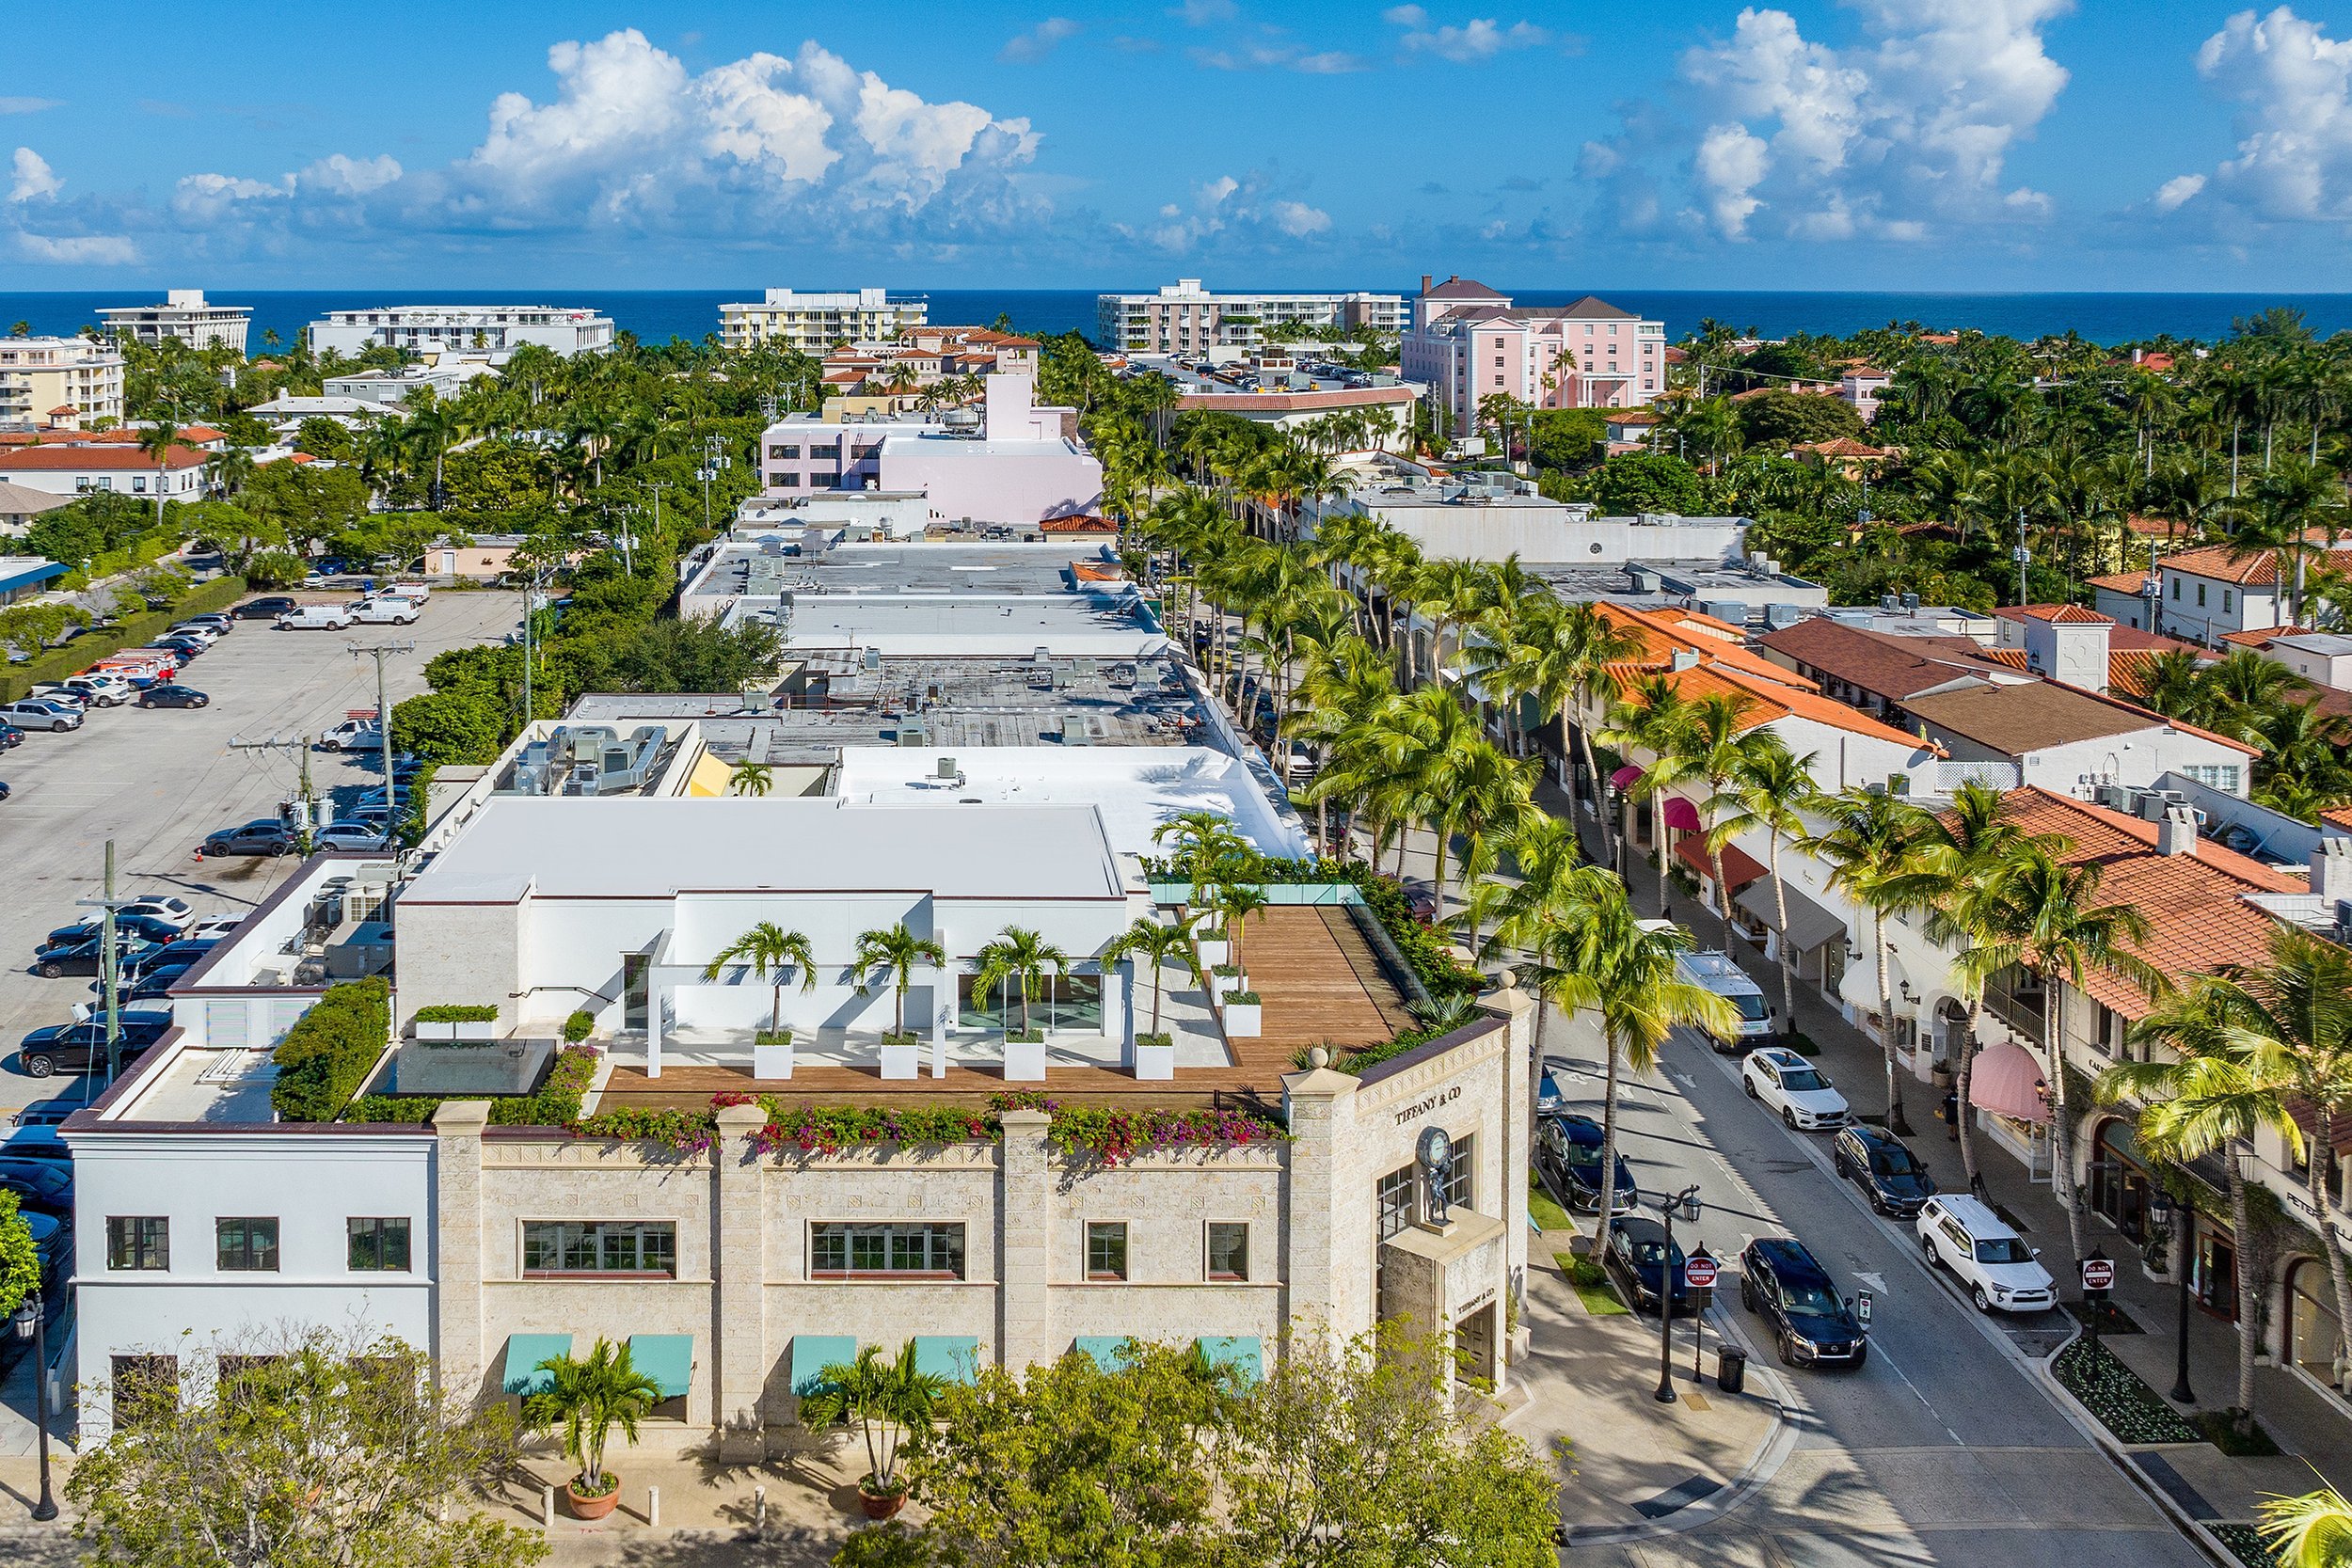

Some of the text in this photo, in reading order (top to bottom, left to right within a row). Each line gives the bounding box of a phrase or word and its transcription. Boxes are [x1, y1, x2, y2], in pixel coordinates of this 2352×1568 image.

[1394, 1085, 1462, 1127] TIFFANY & CO
